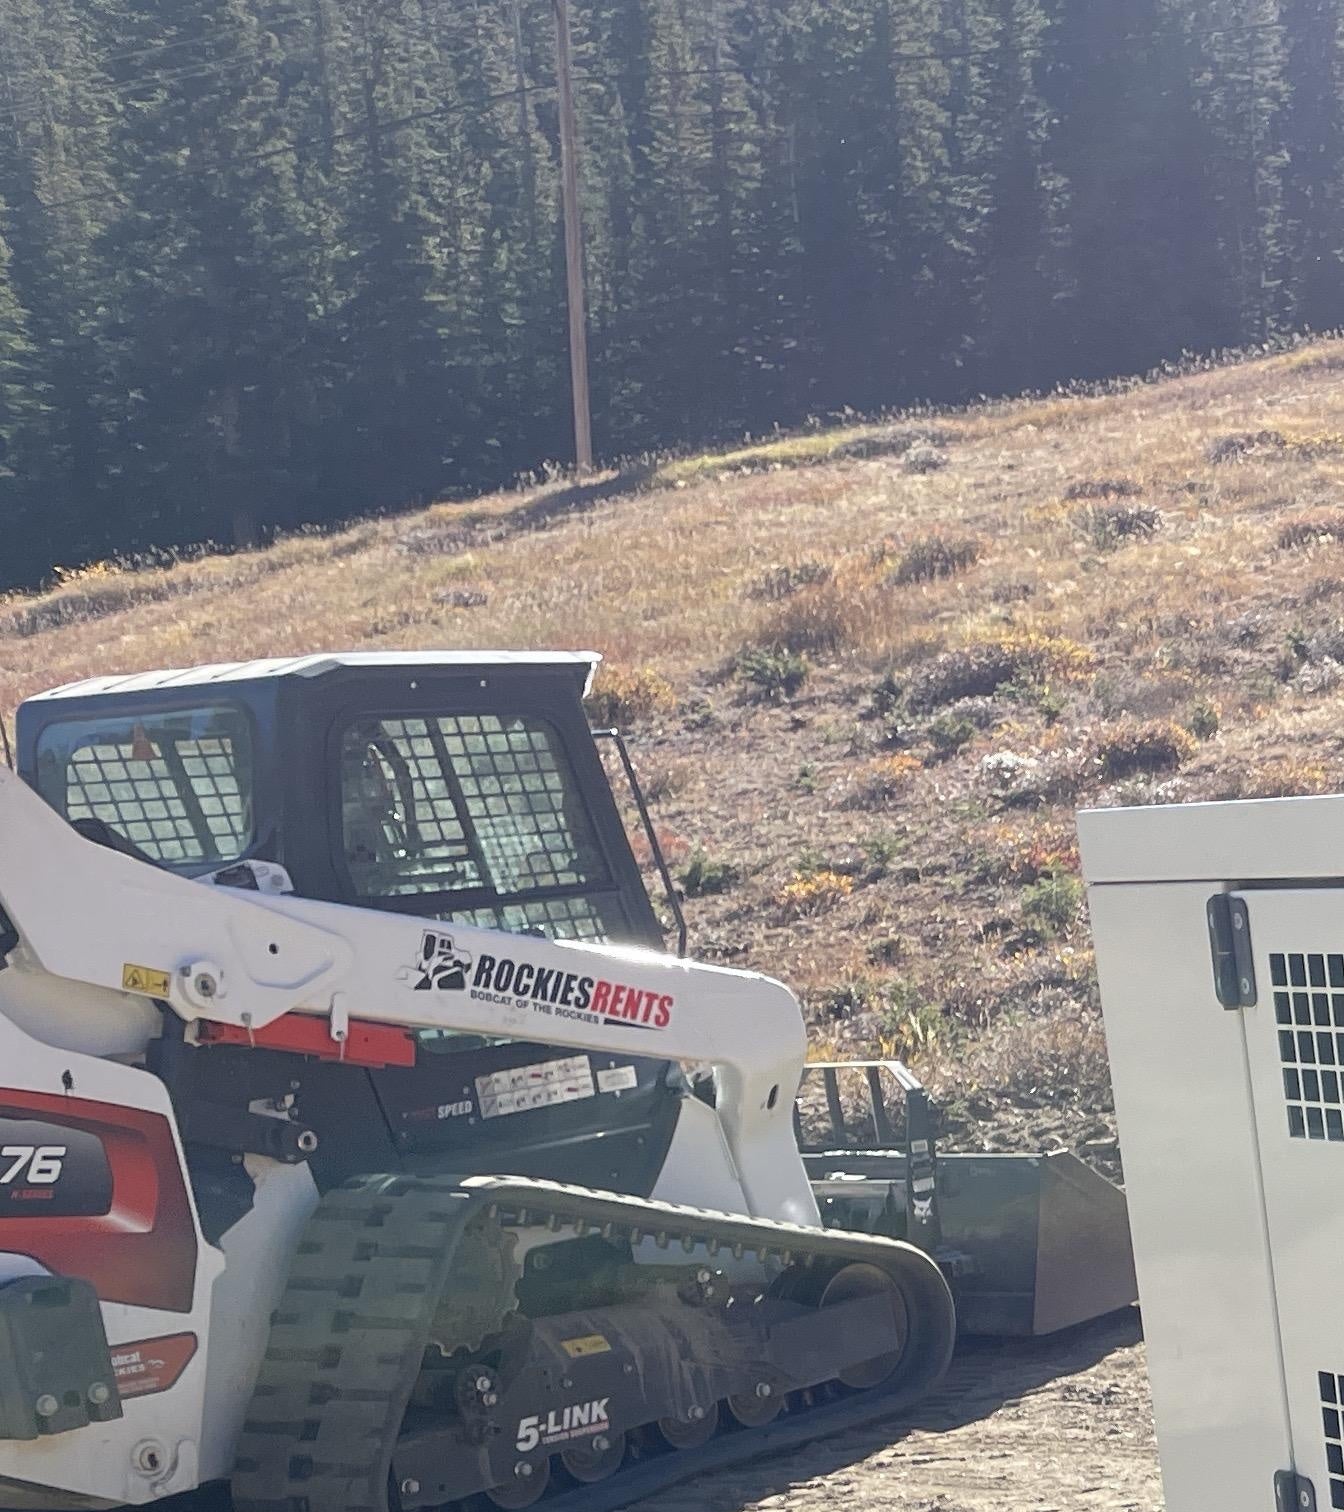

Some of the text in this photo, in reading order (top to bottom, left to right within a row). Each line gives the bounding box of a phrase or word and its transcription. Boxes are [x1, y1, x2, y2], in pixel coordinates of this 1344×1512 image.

[470, 989, 599, 1024] BOBCAT OF THE ROCKIES
[438, 1100, 473, 1119] SPEED
[515, 1397, 610, 1452] 5-LINK
